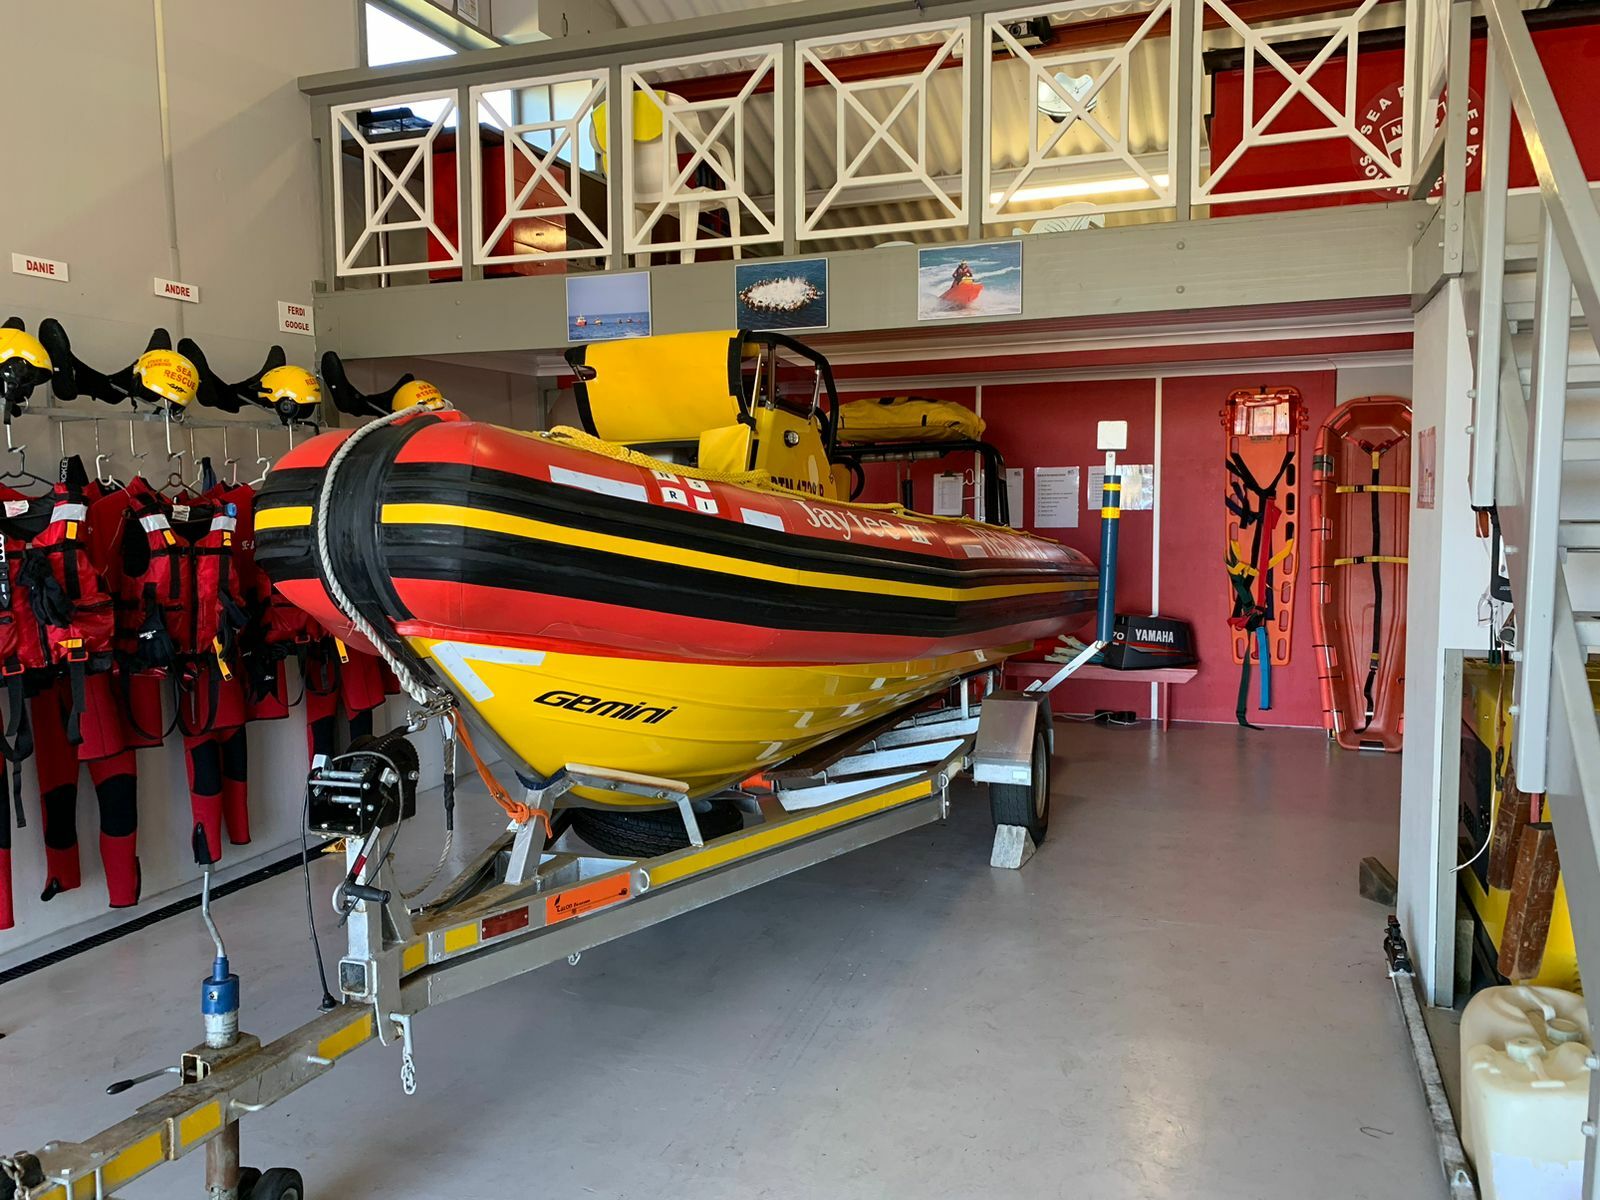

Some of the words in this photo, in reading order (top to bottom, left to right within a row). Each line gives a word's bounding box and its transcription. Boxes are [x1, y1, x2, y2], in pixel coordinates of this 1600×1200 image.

[1360, 98, 1392, 135] SEA
[26, 260, 55, 275] DANIE
[165, 283, 190, 297] ANDRE
[287, 305, 306, 317] FERDI
[285, 320, 310, 331] GOOGLE
[176, 365, 192, 378] SEA
[164, 369, 196, 391] RESCUE
[668, 490, 678, 500] R
[703, 501, 709, 510] I
[792, 499, 901, 541] Jaytee
[1135, 628, 1174, 643] YAMAHA
[533, 690, 678, 724] Gemini
